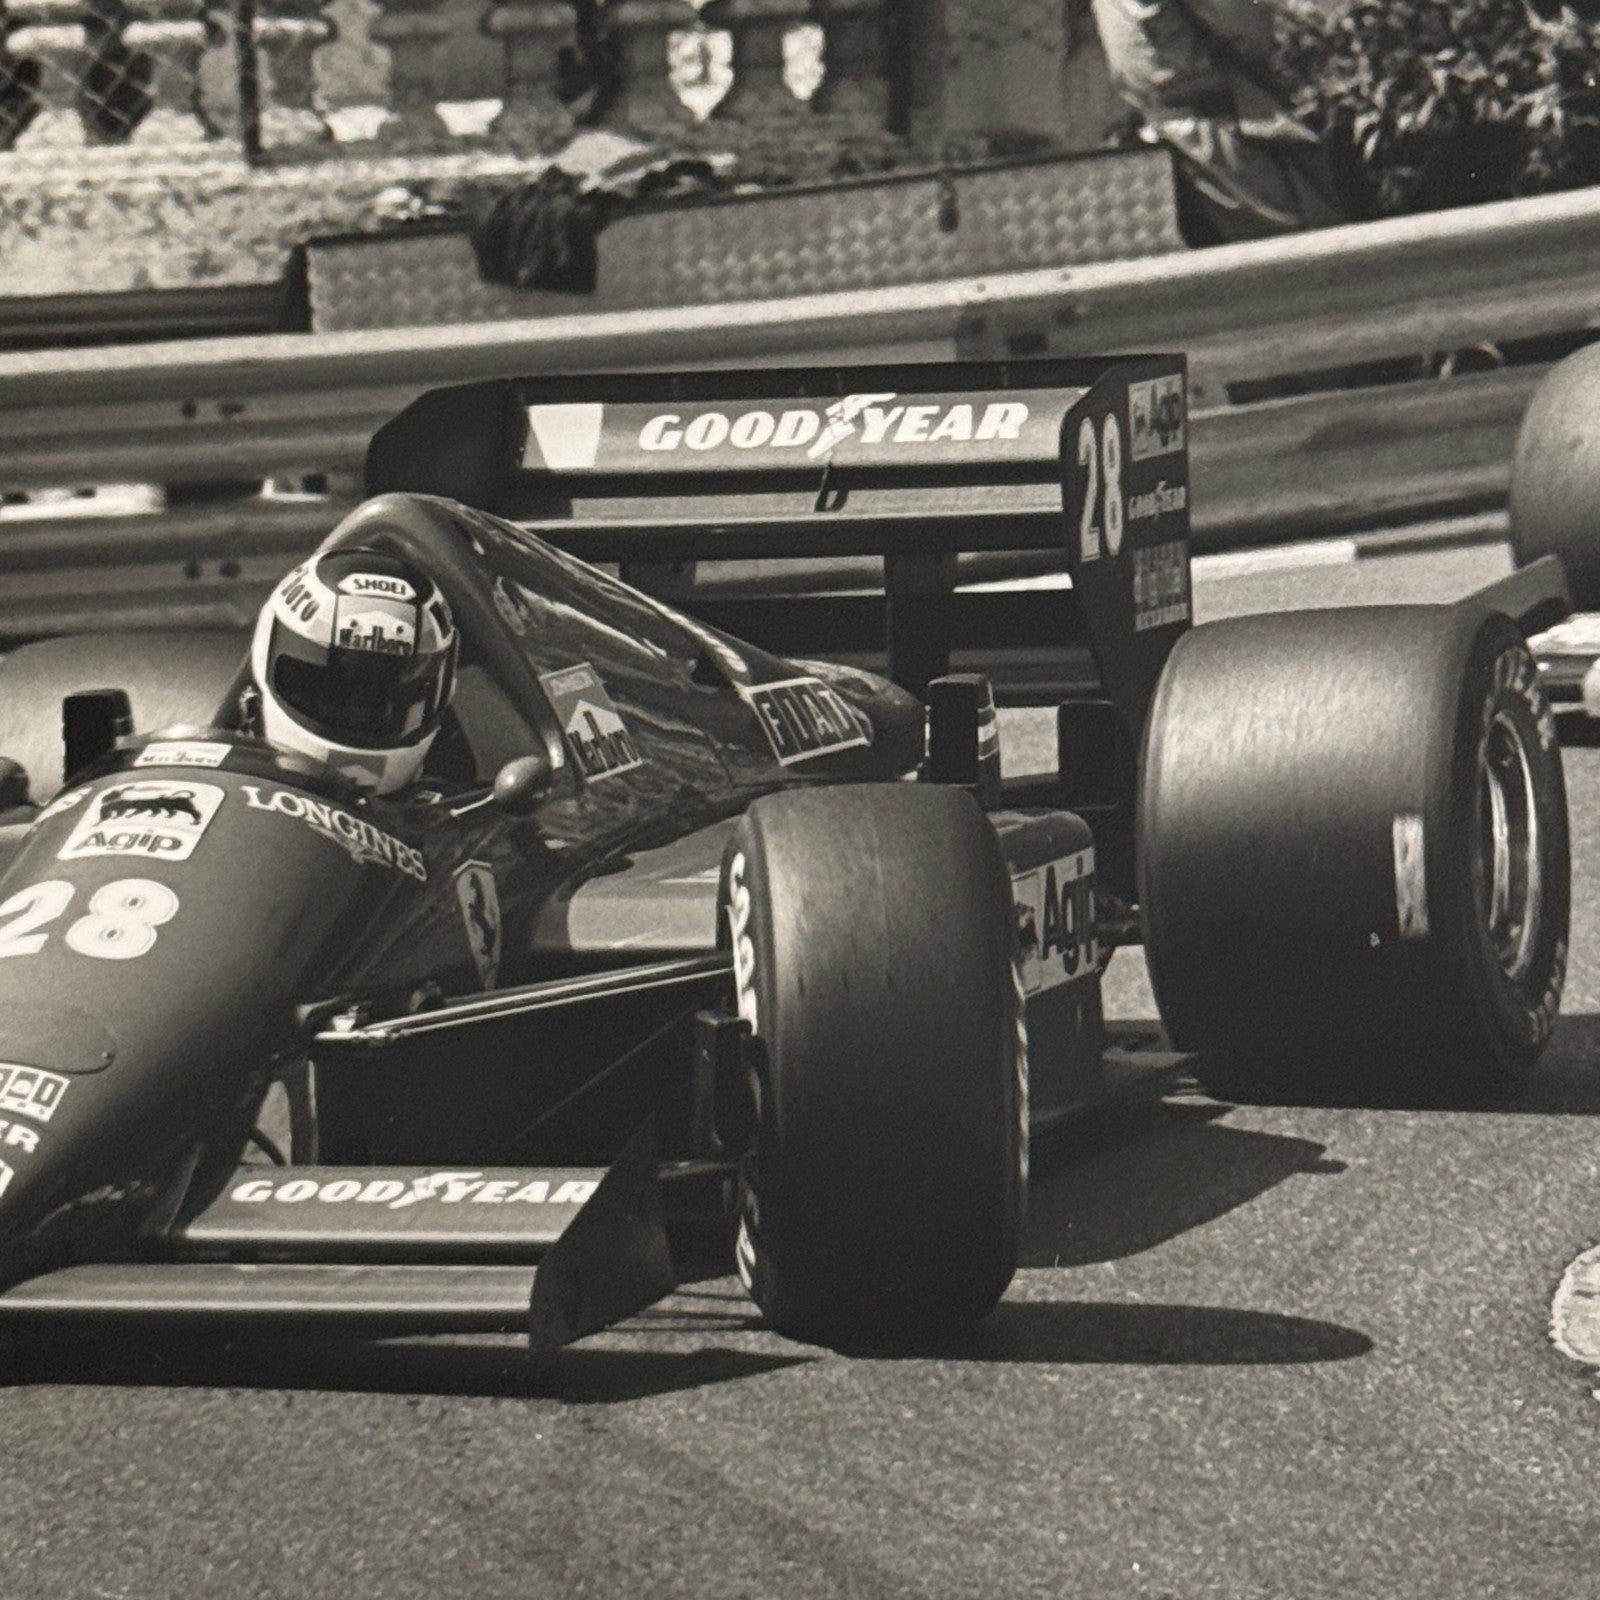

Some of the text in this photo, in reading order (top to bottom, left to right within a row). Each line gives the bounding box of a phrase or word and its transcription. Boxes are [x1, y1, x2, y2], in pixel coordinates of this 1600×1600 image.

[638, 392, 1029, 460] GOODYEAR
[1078, 412, 1123, 563] 28
[353, 577, 407, 596] SHOEI
[761, 690, 850, 746] FIAT
[72, 829, 183, 853] Agip
[241, 785, 427, 882] LONGINES
[0, 878, 180, 960] 28
